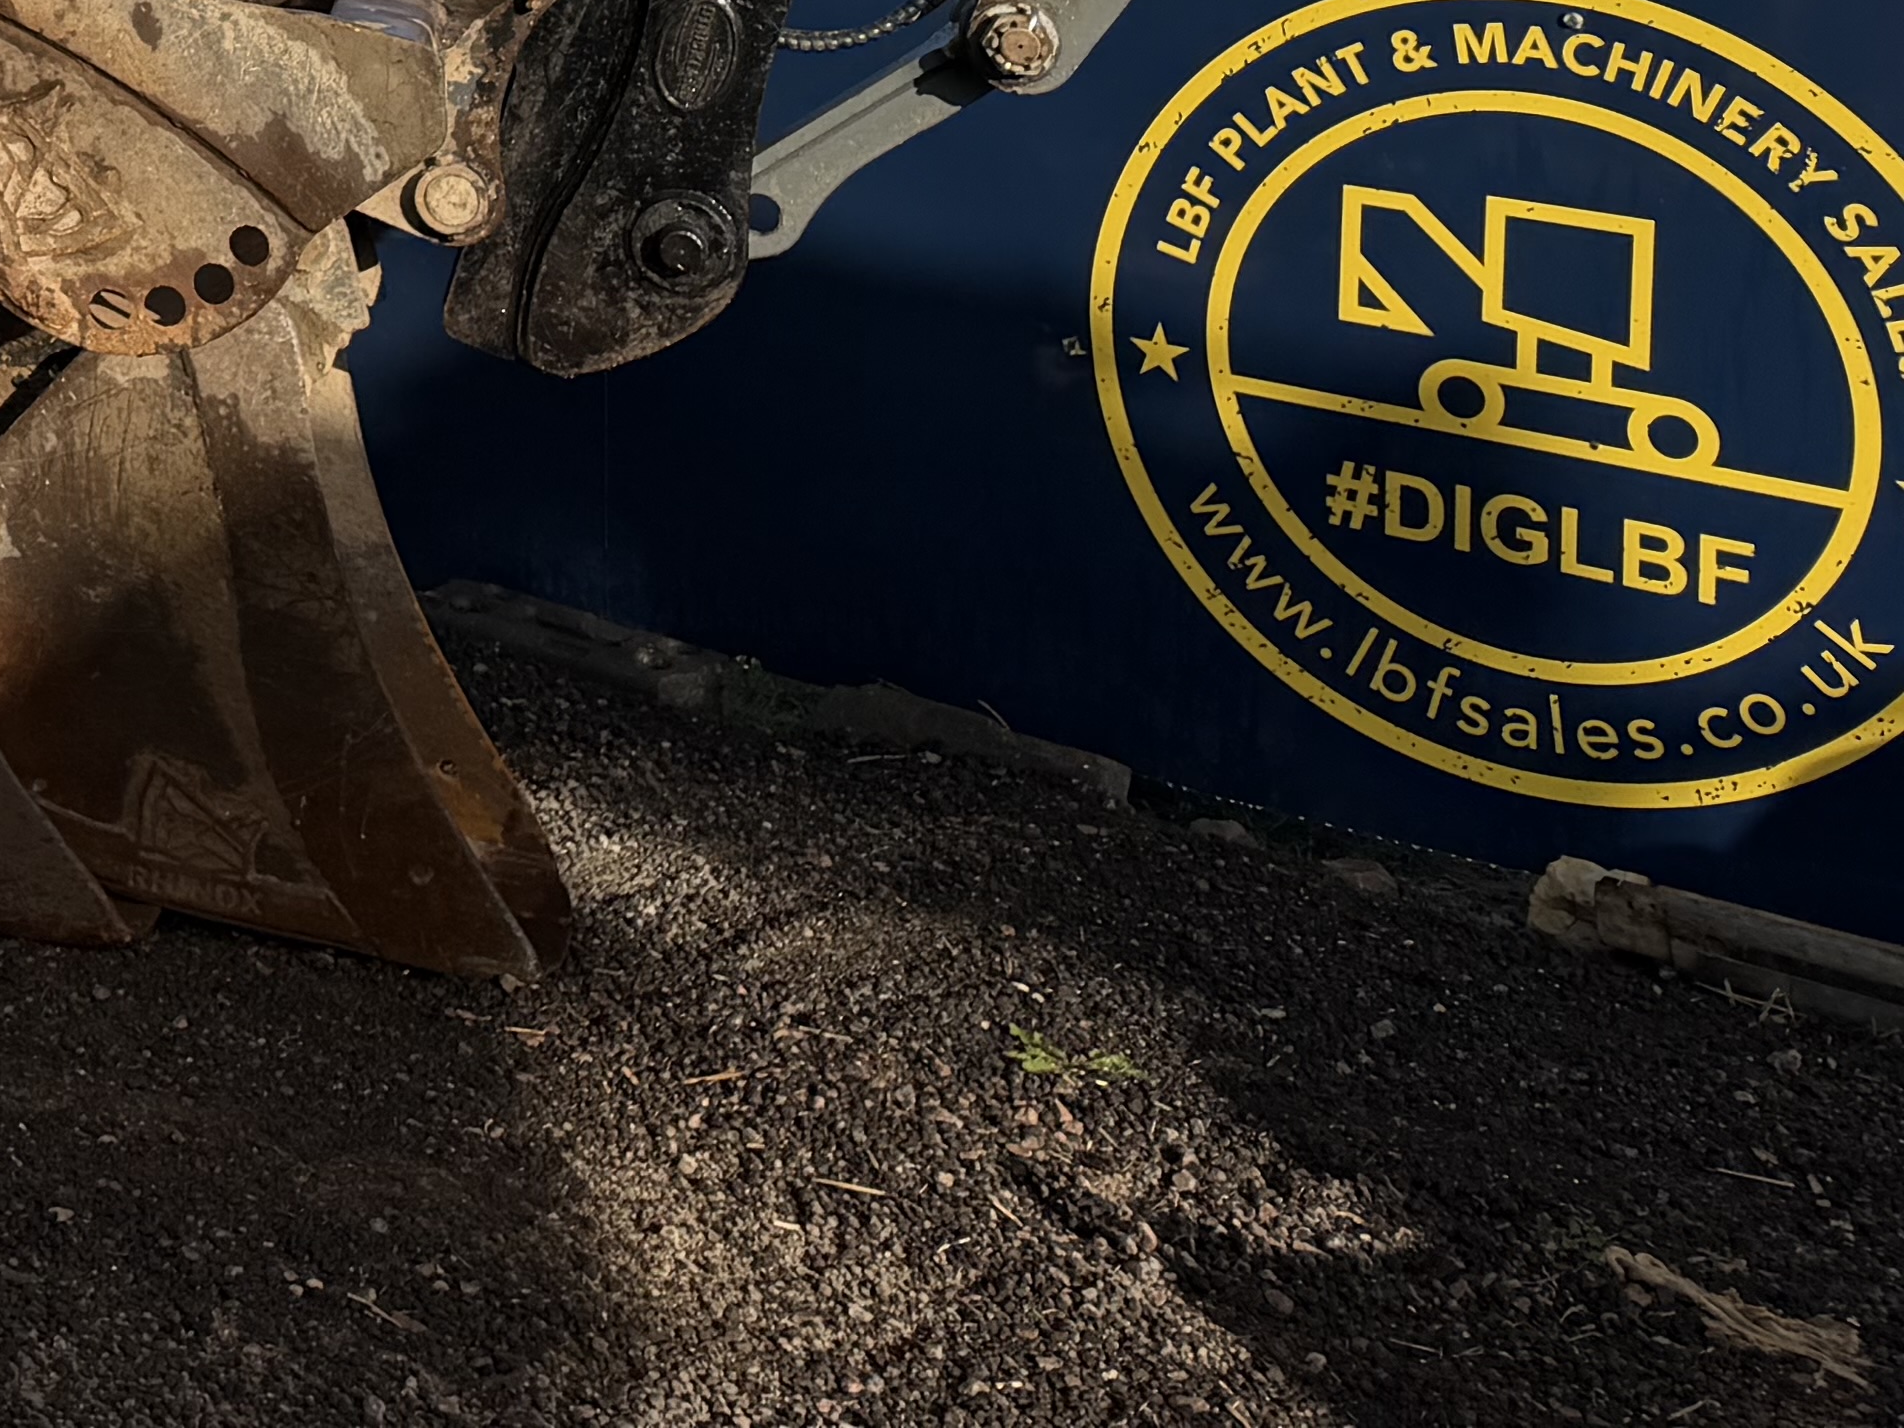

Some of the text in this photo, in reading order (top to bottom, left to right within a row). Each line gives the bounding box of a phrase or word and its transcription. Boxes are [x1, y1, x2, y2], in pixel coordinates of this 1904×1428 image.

[1156, 166, 1220, 264] LBF
[1208, 42, 1369, 172] PLANT
[1390, 29, 1438, 72] &
[1452, 22, 1839, 193] MACHINERY
[1189, 482, 1895, 761] www.lbfsales.co.uk
[1325, 460, 1756, 605] #DIGLBF
